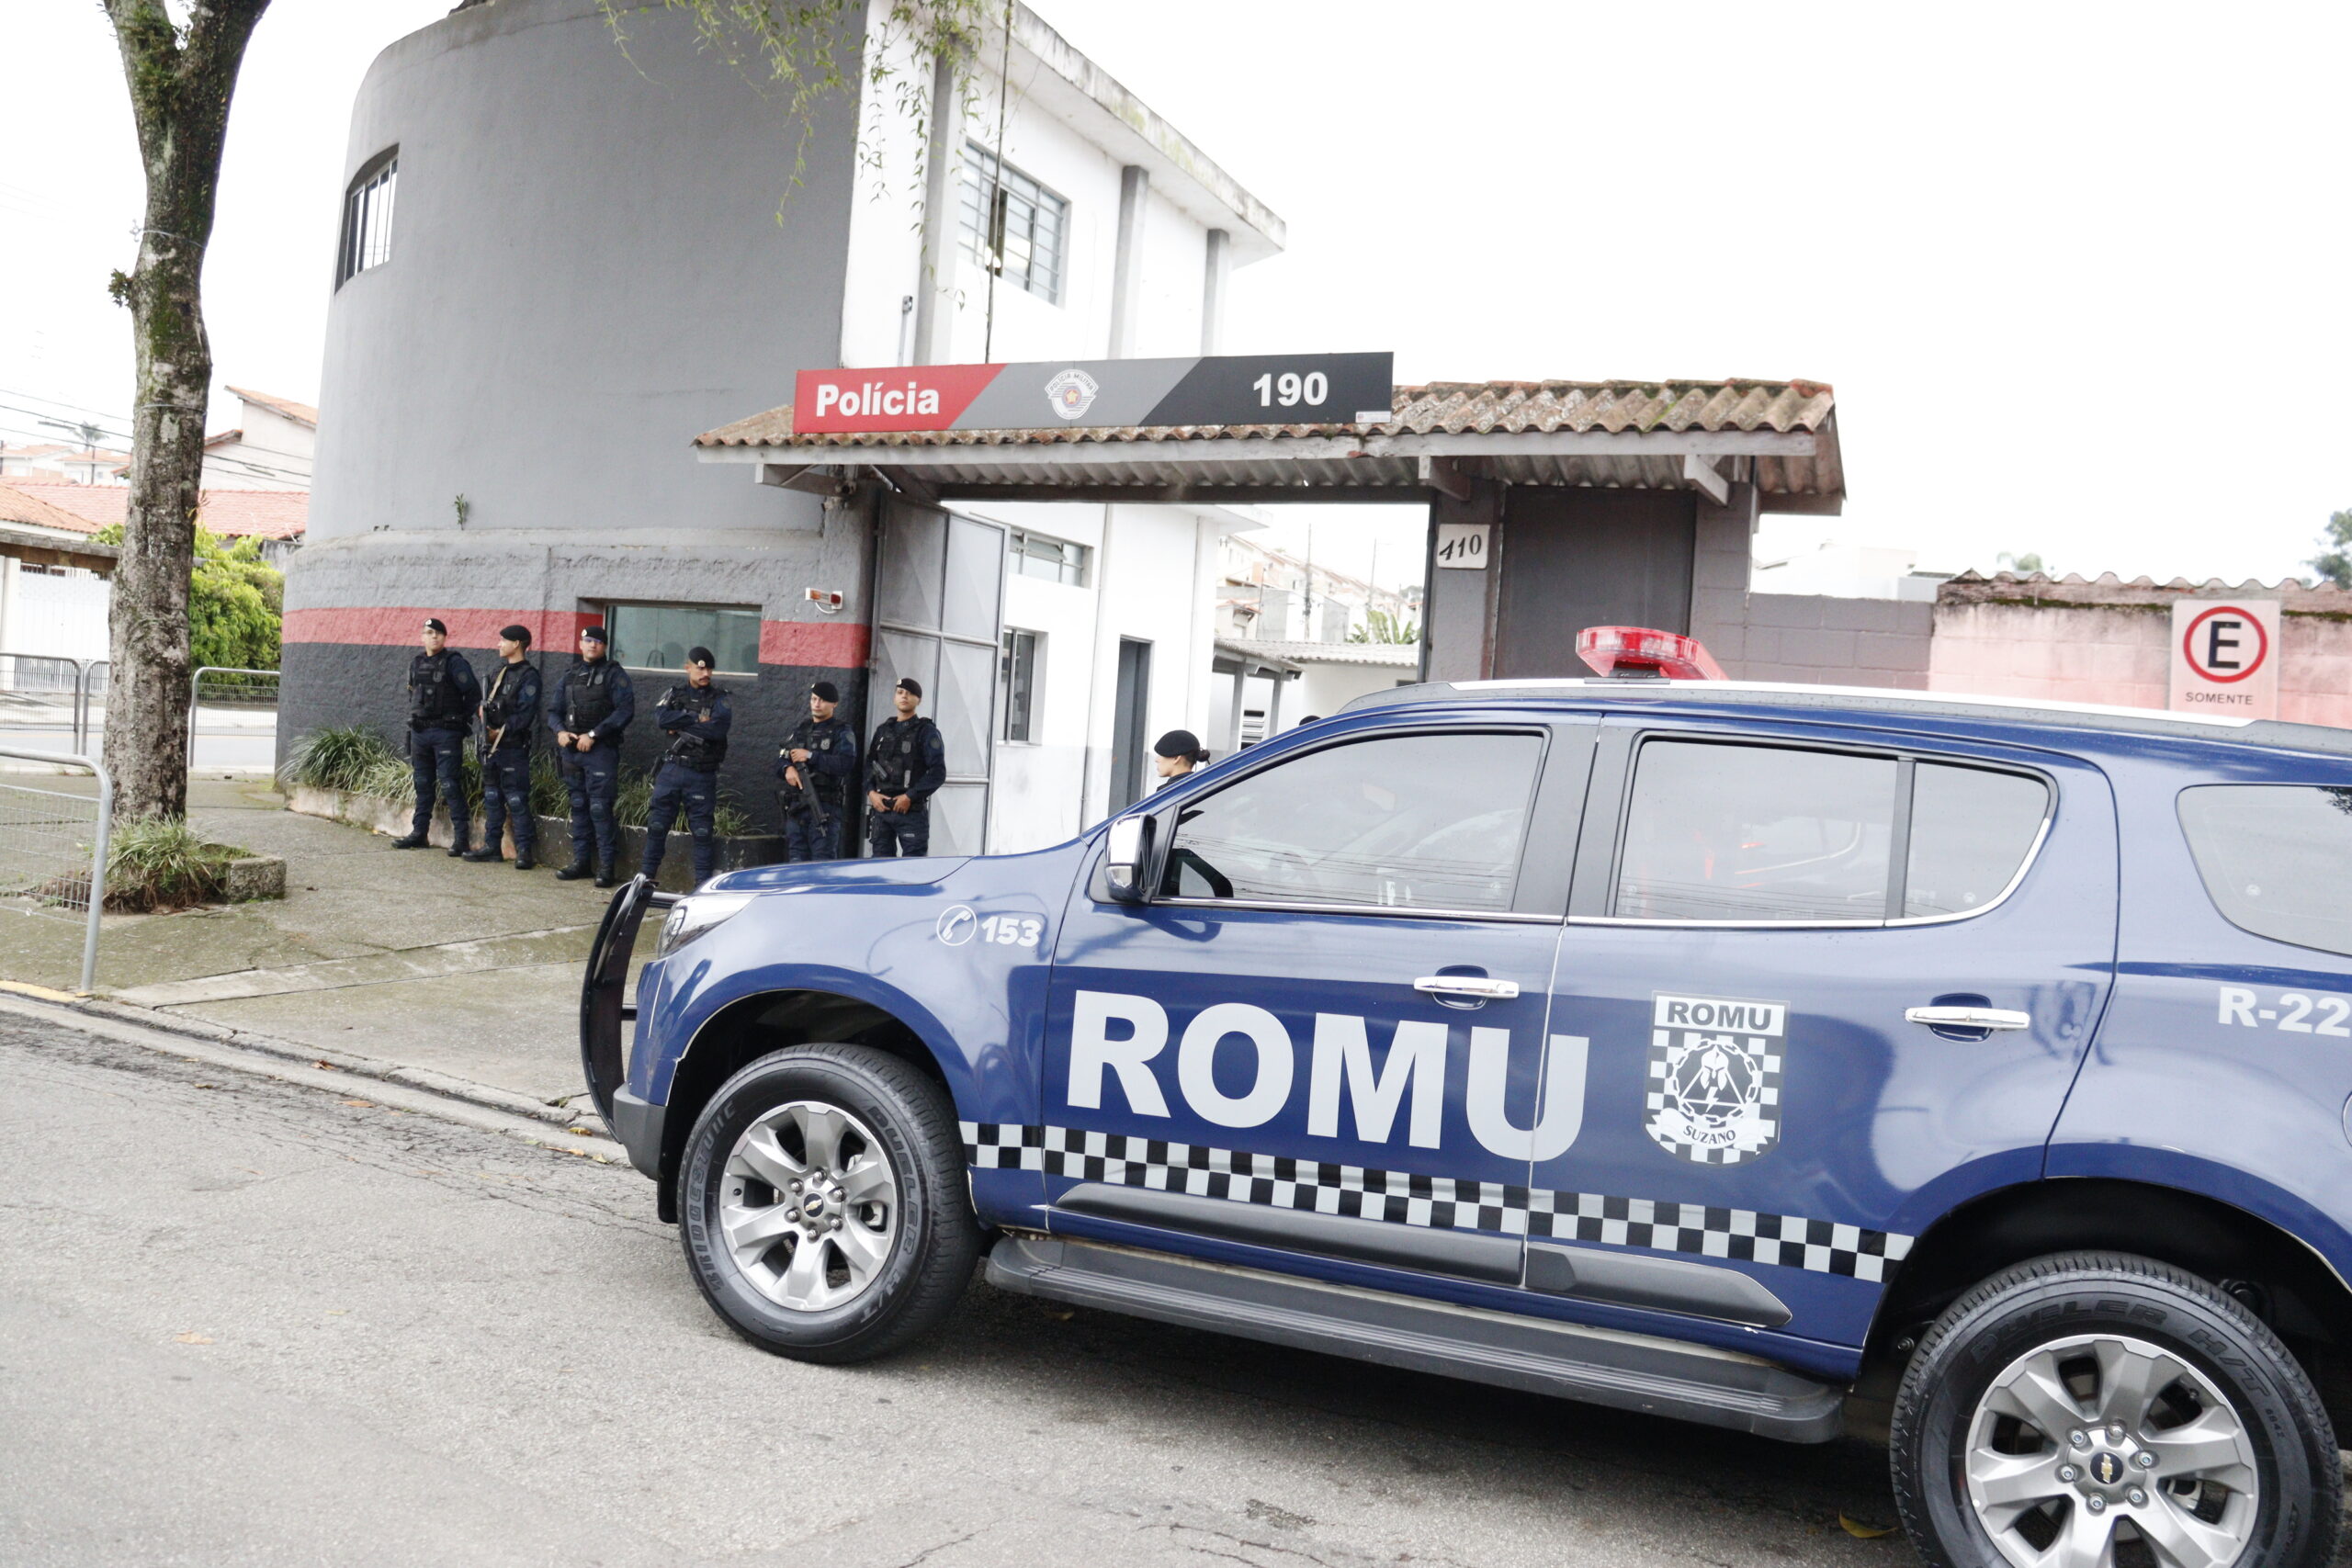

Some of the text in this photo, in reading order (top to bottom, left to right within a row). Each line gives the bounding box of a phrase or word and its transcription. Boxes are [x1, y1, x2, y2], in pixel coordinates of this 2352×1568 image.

[816, 381, 939, 417] Polícia
[1253, 371, 1328, 407] 190
[1439, 534, 1482, 561] 410
[2208, 620, 2242, 670] E
[2185, 691, 2255, 705] SOMENTE
[981, 915, 1041, 947] 153
[1667, 1000, 1772, 1031] ROMU
[2218, 986, 2351, 1038] R-22
[1067, 988, 1589, 1162] ROMU
[1682, 1124, 1736, 1145] SUZANO
[866, 1105, 918, 1256] DUELER
[1969, 1299, 2167, 1360] DUELER
